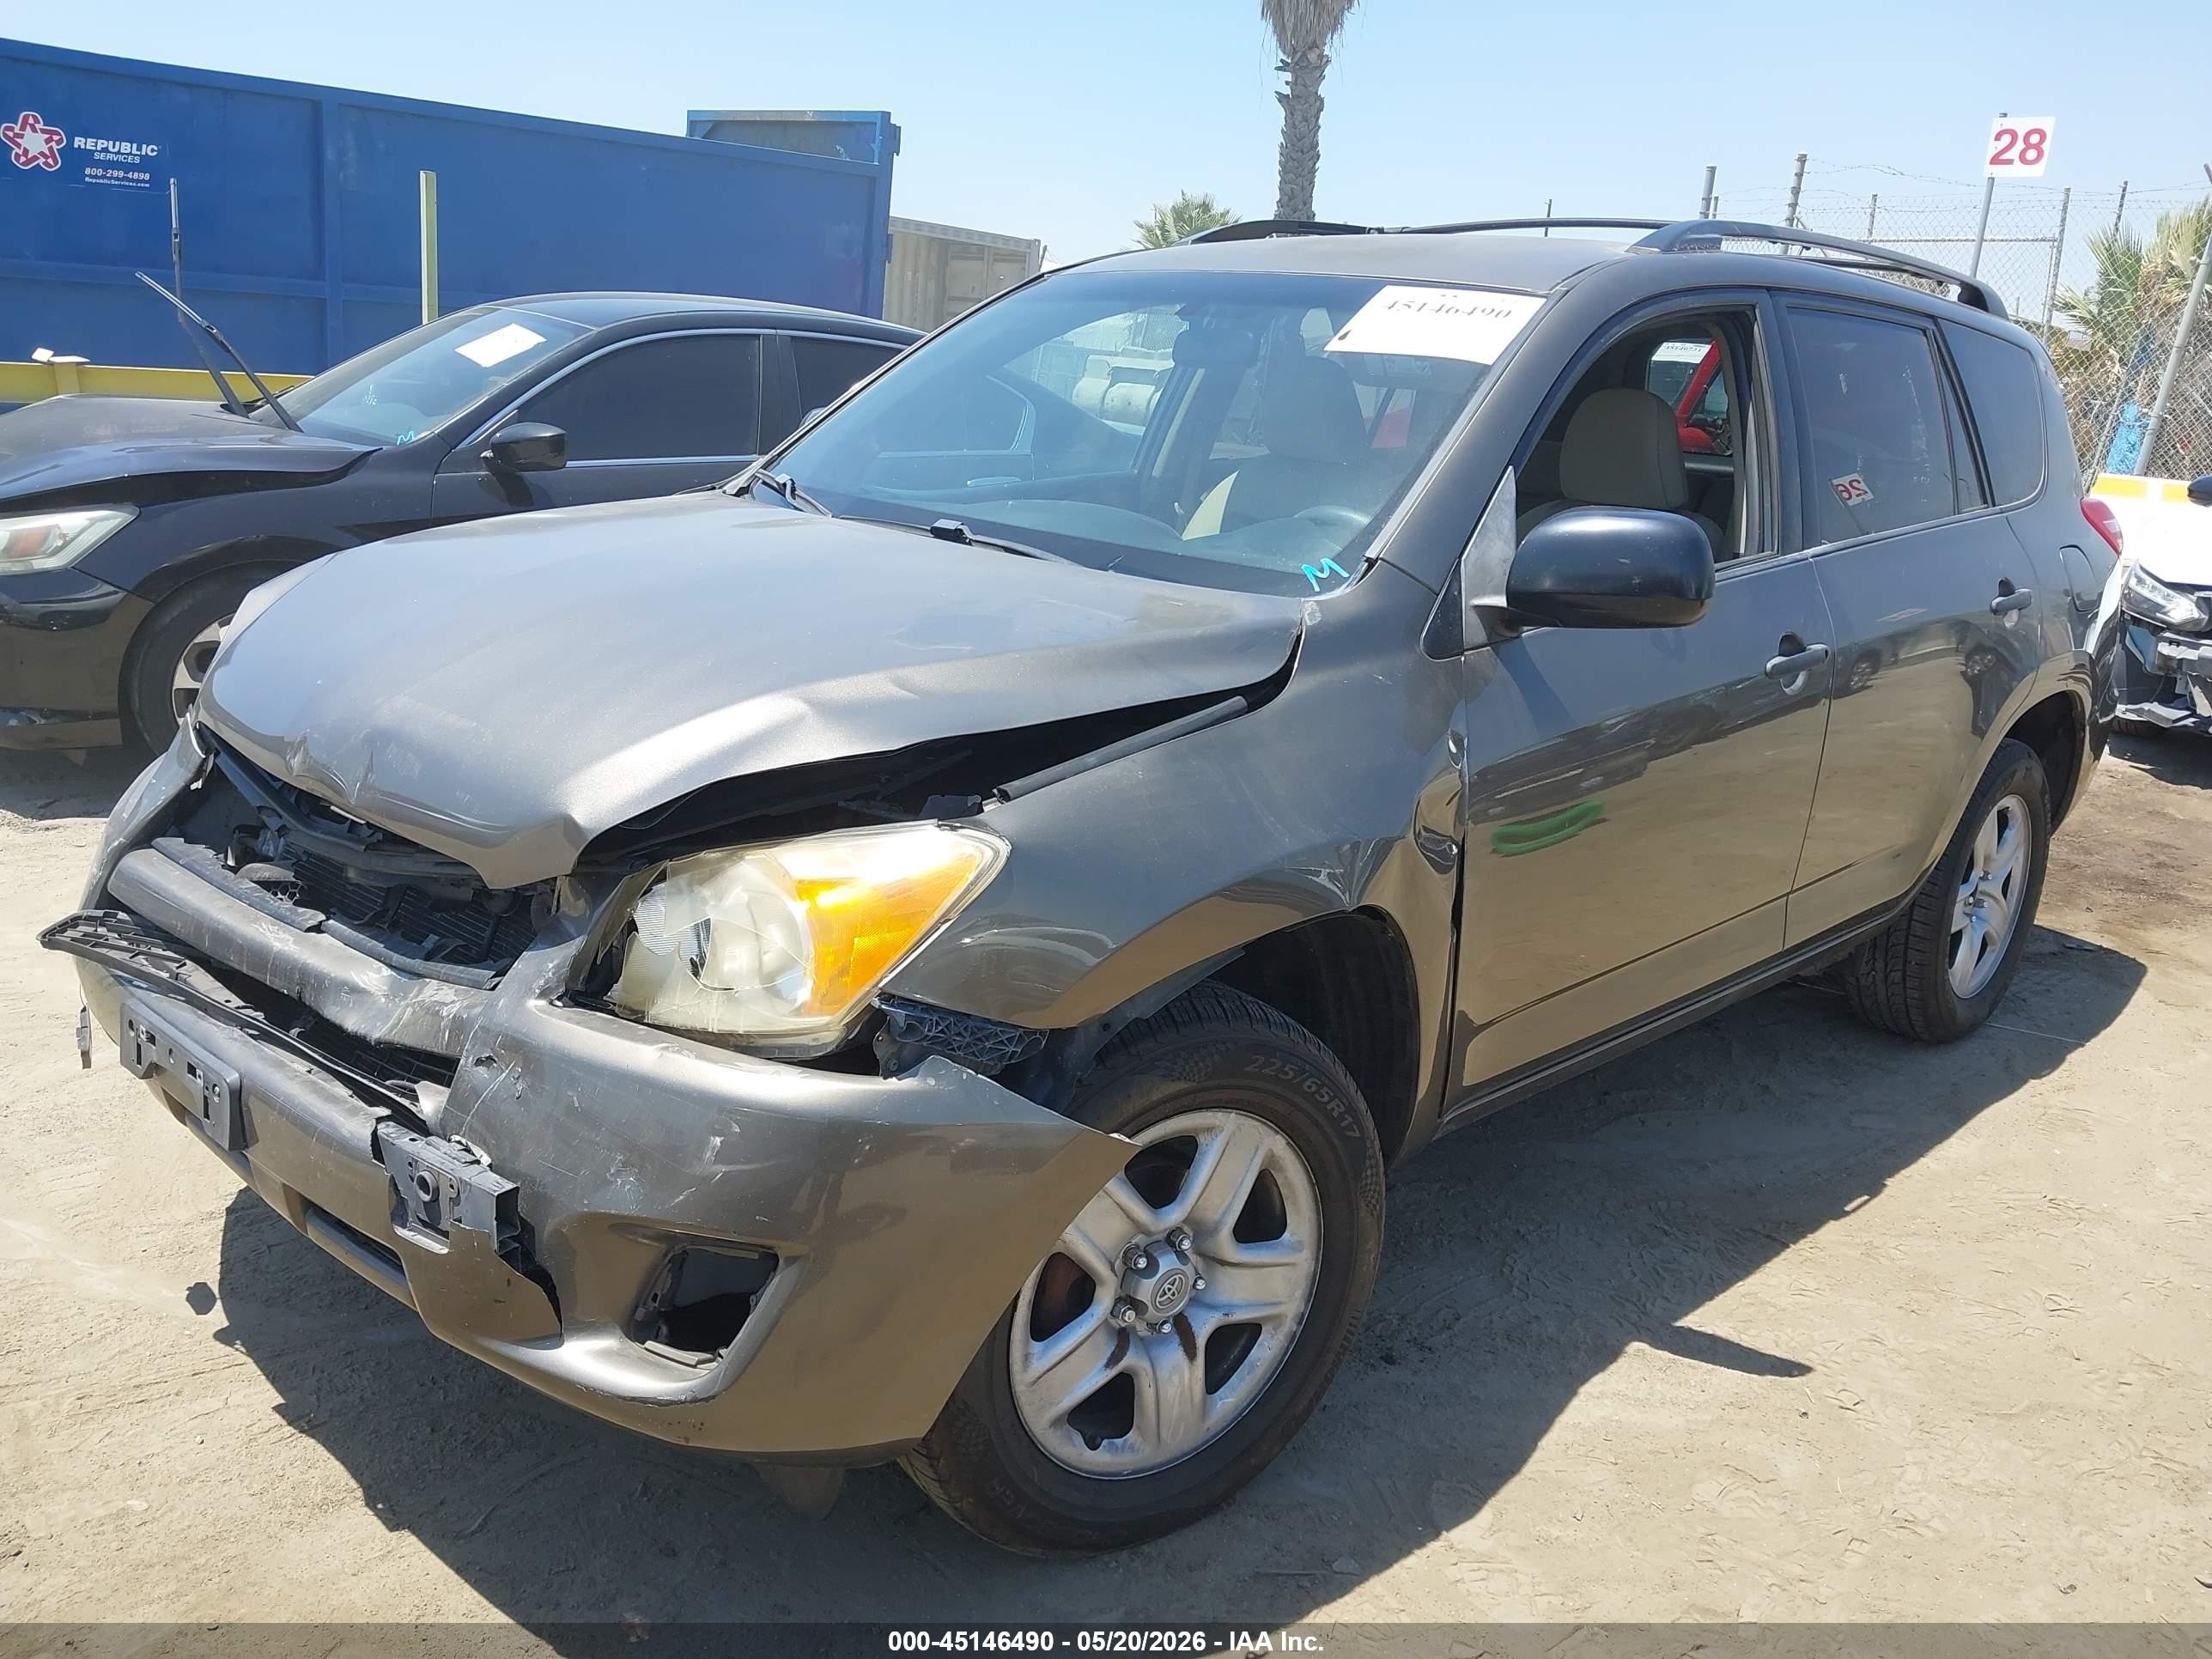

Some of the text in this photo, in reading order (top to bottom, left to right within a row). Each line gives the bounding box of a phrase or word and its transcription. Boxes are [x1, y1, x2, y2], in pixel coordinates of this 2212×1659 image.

[74, 137, 158, 156] REPUBLIC
[1989, 128, 2047, 166] 28
[94, 152, 141, 164] SERVICES
[84, 167, 150, 180] 800-299-4898
[84, 176, 150, 188] RepublicServices.com
[1301, 557, 1350, 592] M
[1245, 1054, 1362, 1139] 225/65R17
